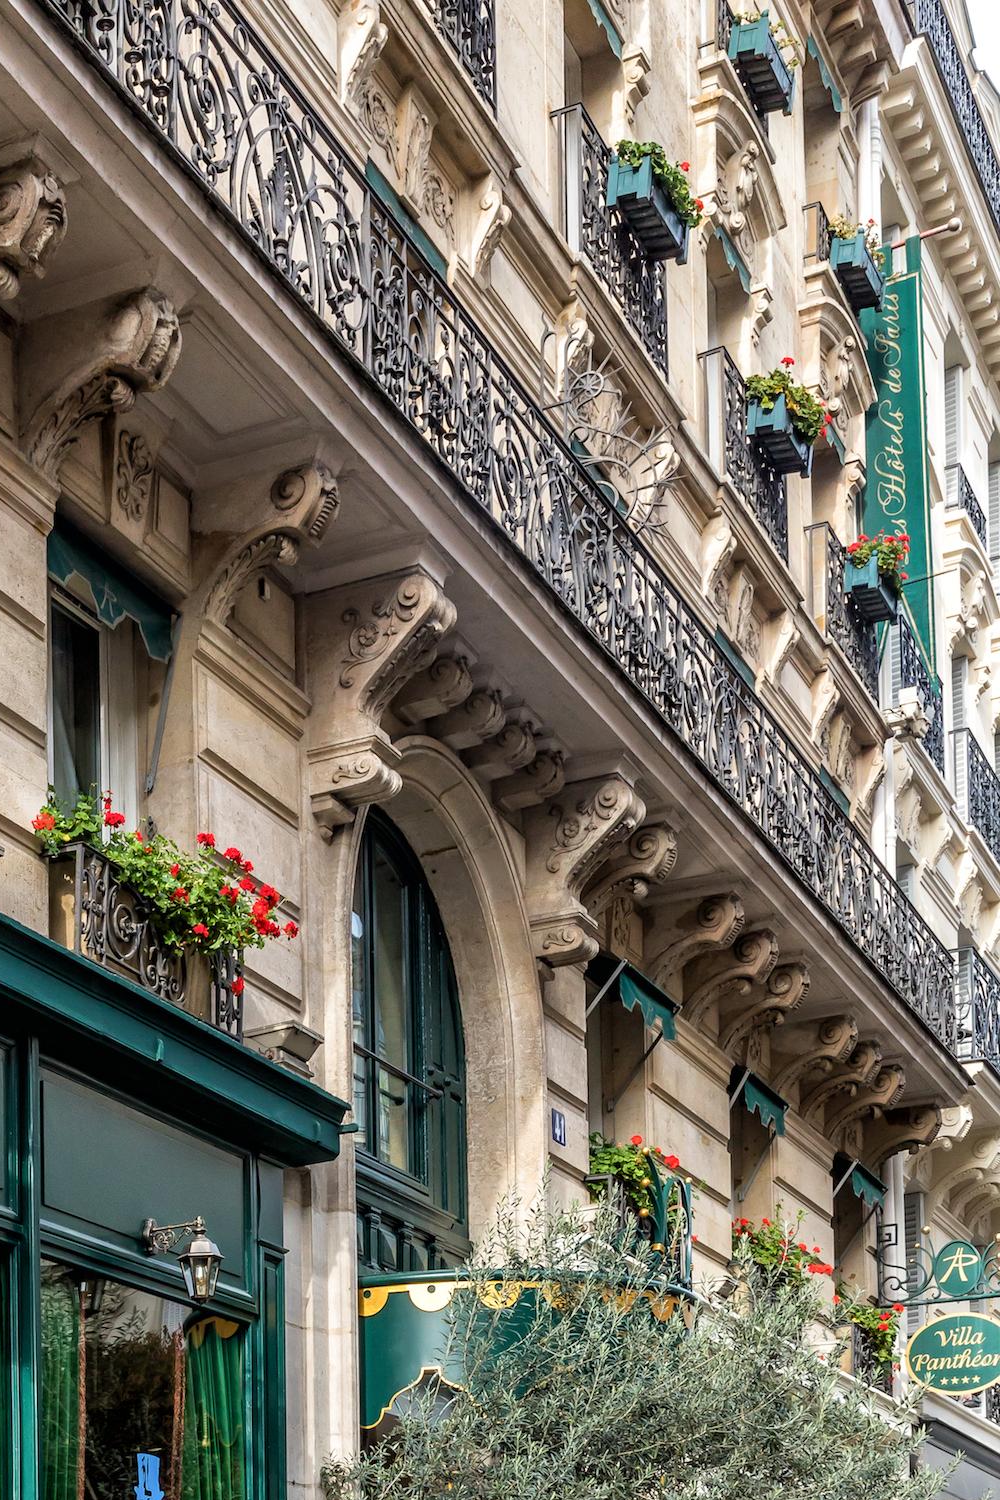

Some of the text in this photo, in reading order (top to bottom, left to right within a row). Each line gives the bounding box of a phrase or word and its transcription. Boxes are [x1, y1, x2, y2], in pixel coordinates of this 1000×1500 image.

[874, 292, 902, 367] Paris
[879, 368, 902, 393] de
[874, 400, 907, 516] Hôtels
[554, 1111, 565, 1145] 41
[934, 1325, 985, 1348] Villa
